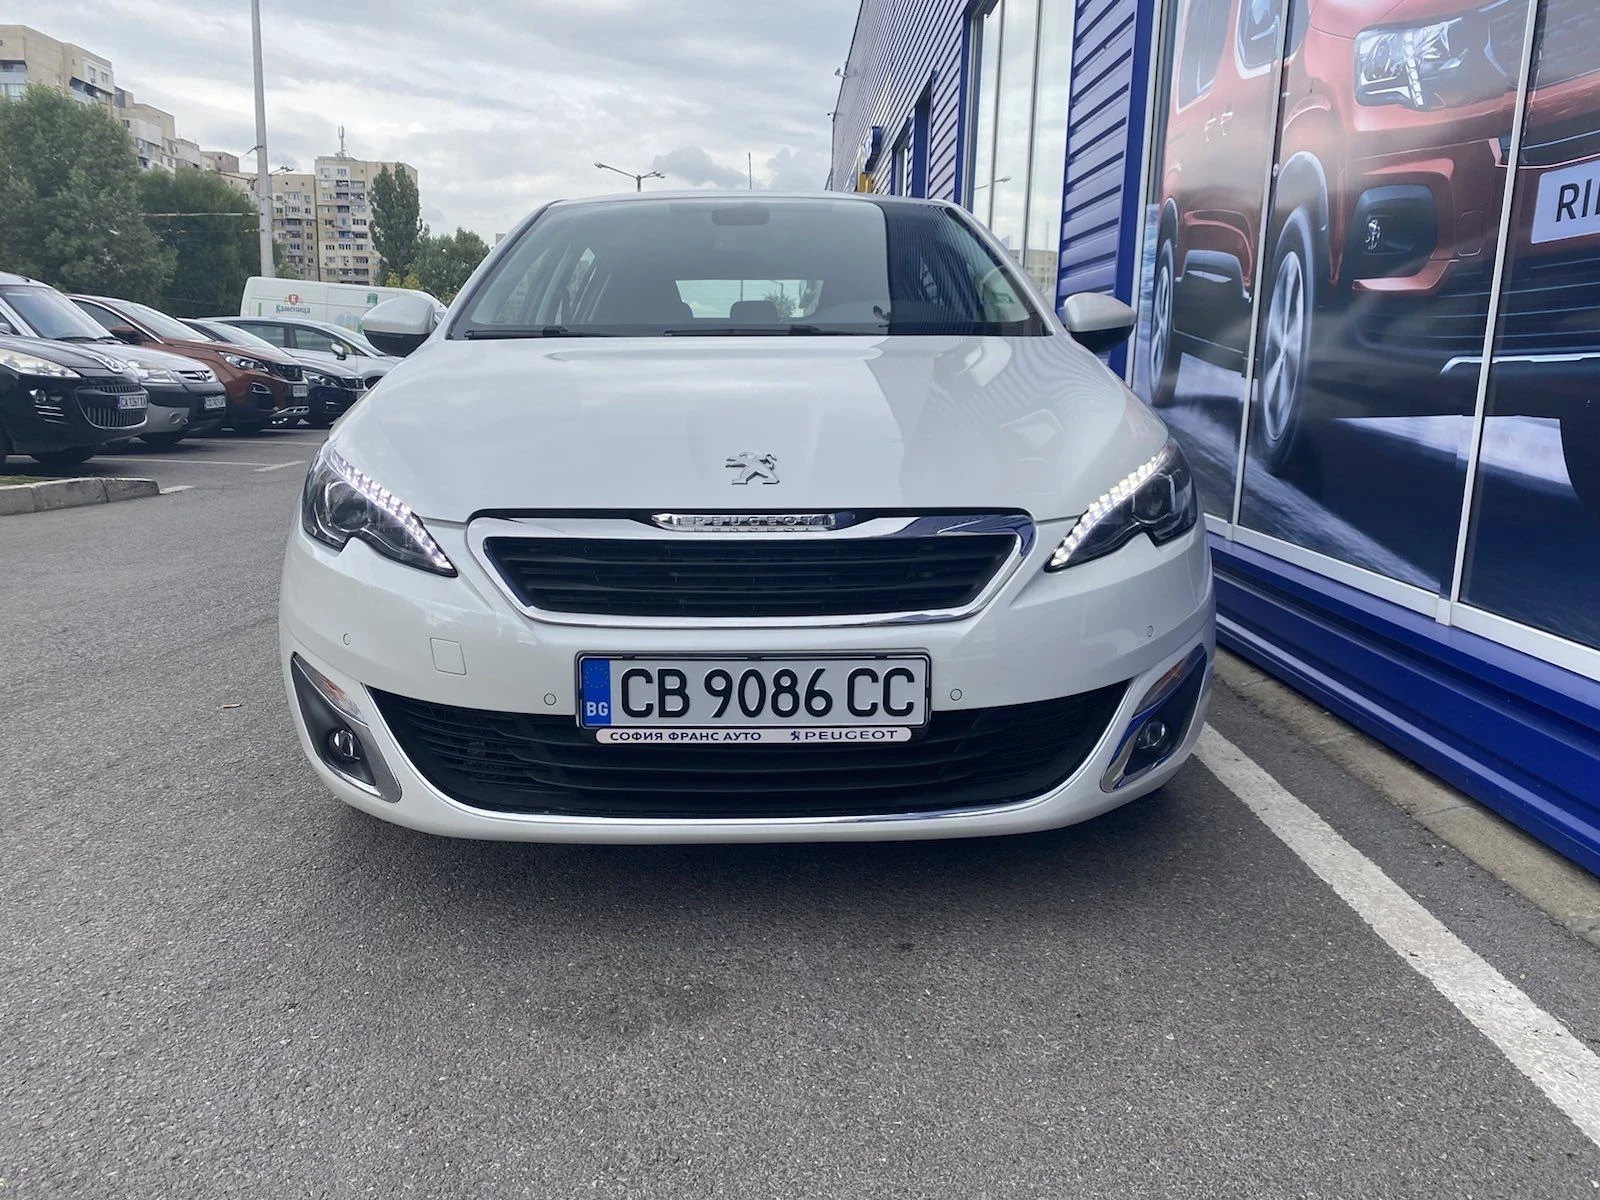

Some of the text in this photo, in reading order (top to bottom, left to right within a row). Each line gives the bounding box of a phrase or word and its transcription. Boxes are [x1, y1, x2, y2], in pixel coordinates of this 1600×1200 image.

[1555, 178, 1600, 222] RI
[693, 515, 814, 526] PEUGEOT
[621, 667, 915, 718] CB 9086 CC
[586, 701, 609, 716] BG
[610, 732, 762, 741] СОФИЯ ФРАНС АУТО
[805, 730, 898, 740] PEUGEOT
